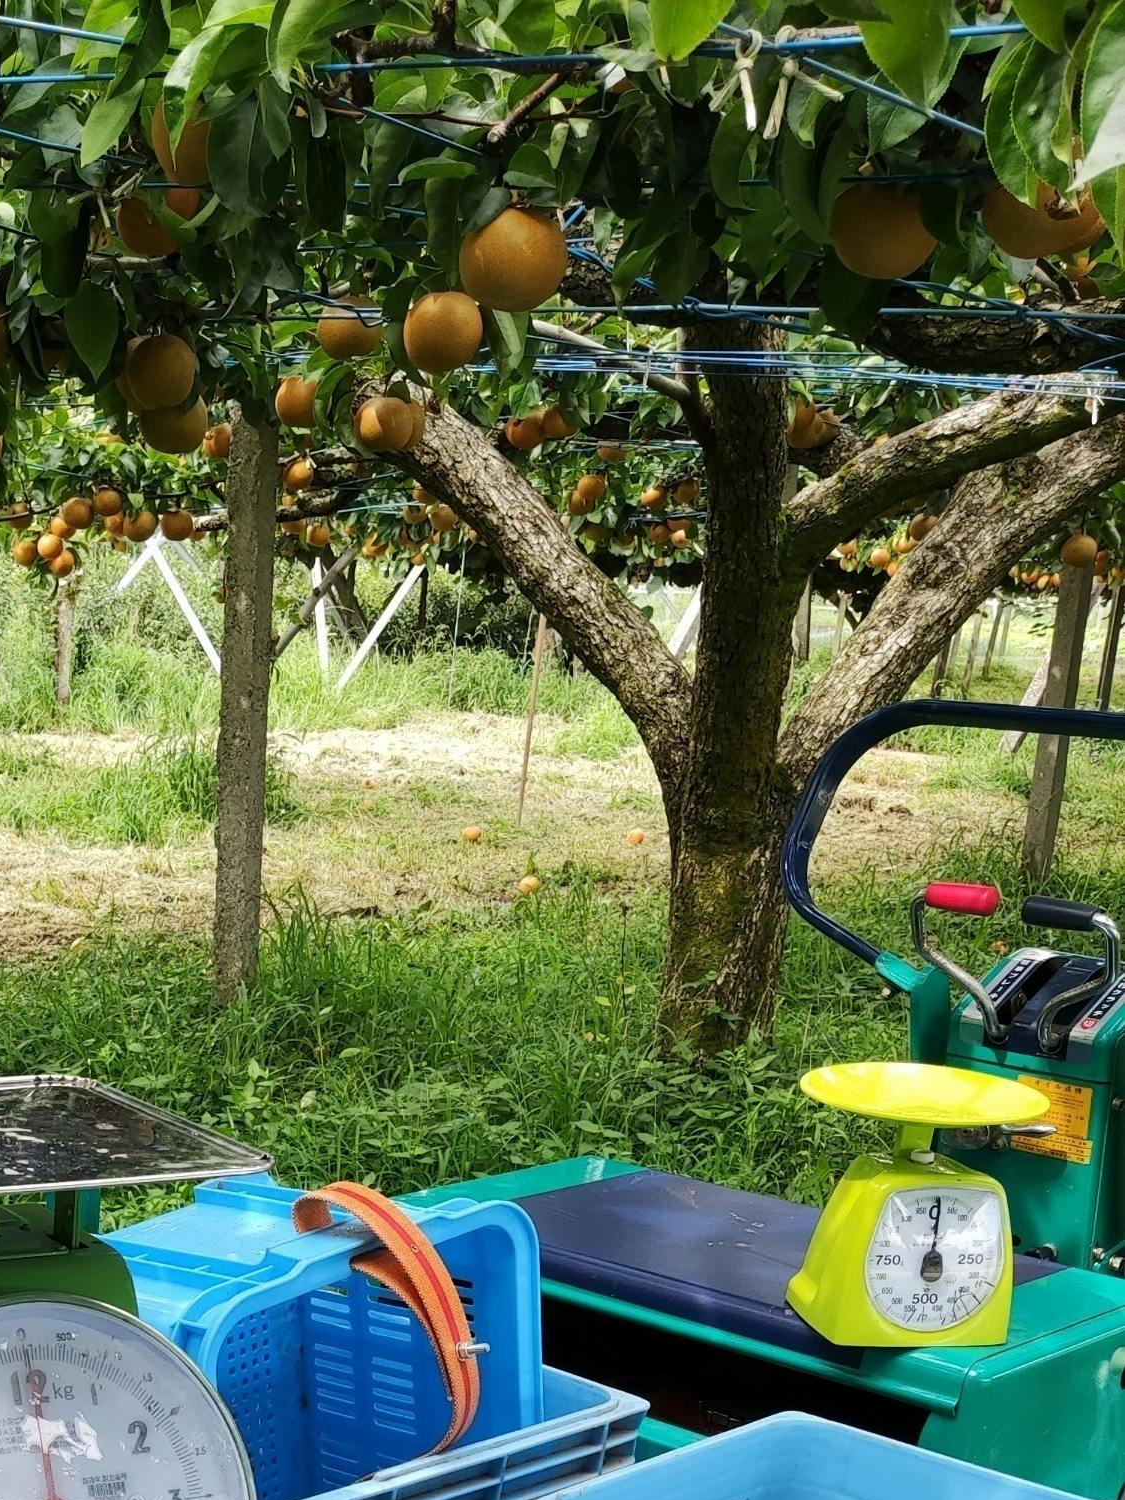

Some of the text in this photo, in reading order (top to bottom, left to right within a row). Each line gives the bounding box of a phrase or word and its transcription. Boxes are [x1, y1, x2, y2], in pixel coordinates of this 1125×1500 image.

[958, 1253, 984, 1265] 250
[881, 1286, 893, 1295] 650
[891, 1297, 903, 1305] 600
[912, 1293, 938, 1305] 500
[10, 1368, 75, 1406] 12 kg
[127, 1420, 151, 1455] 2
